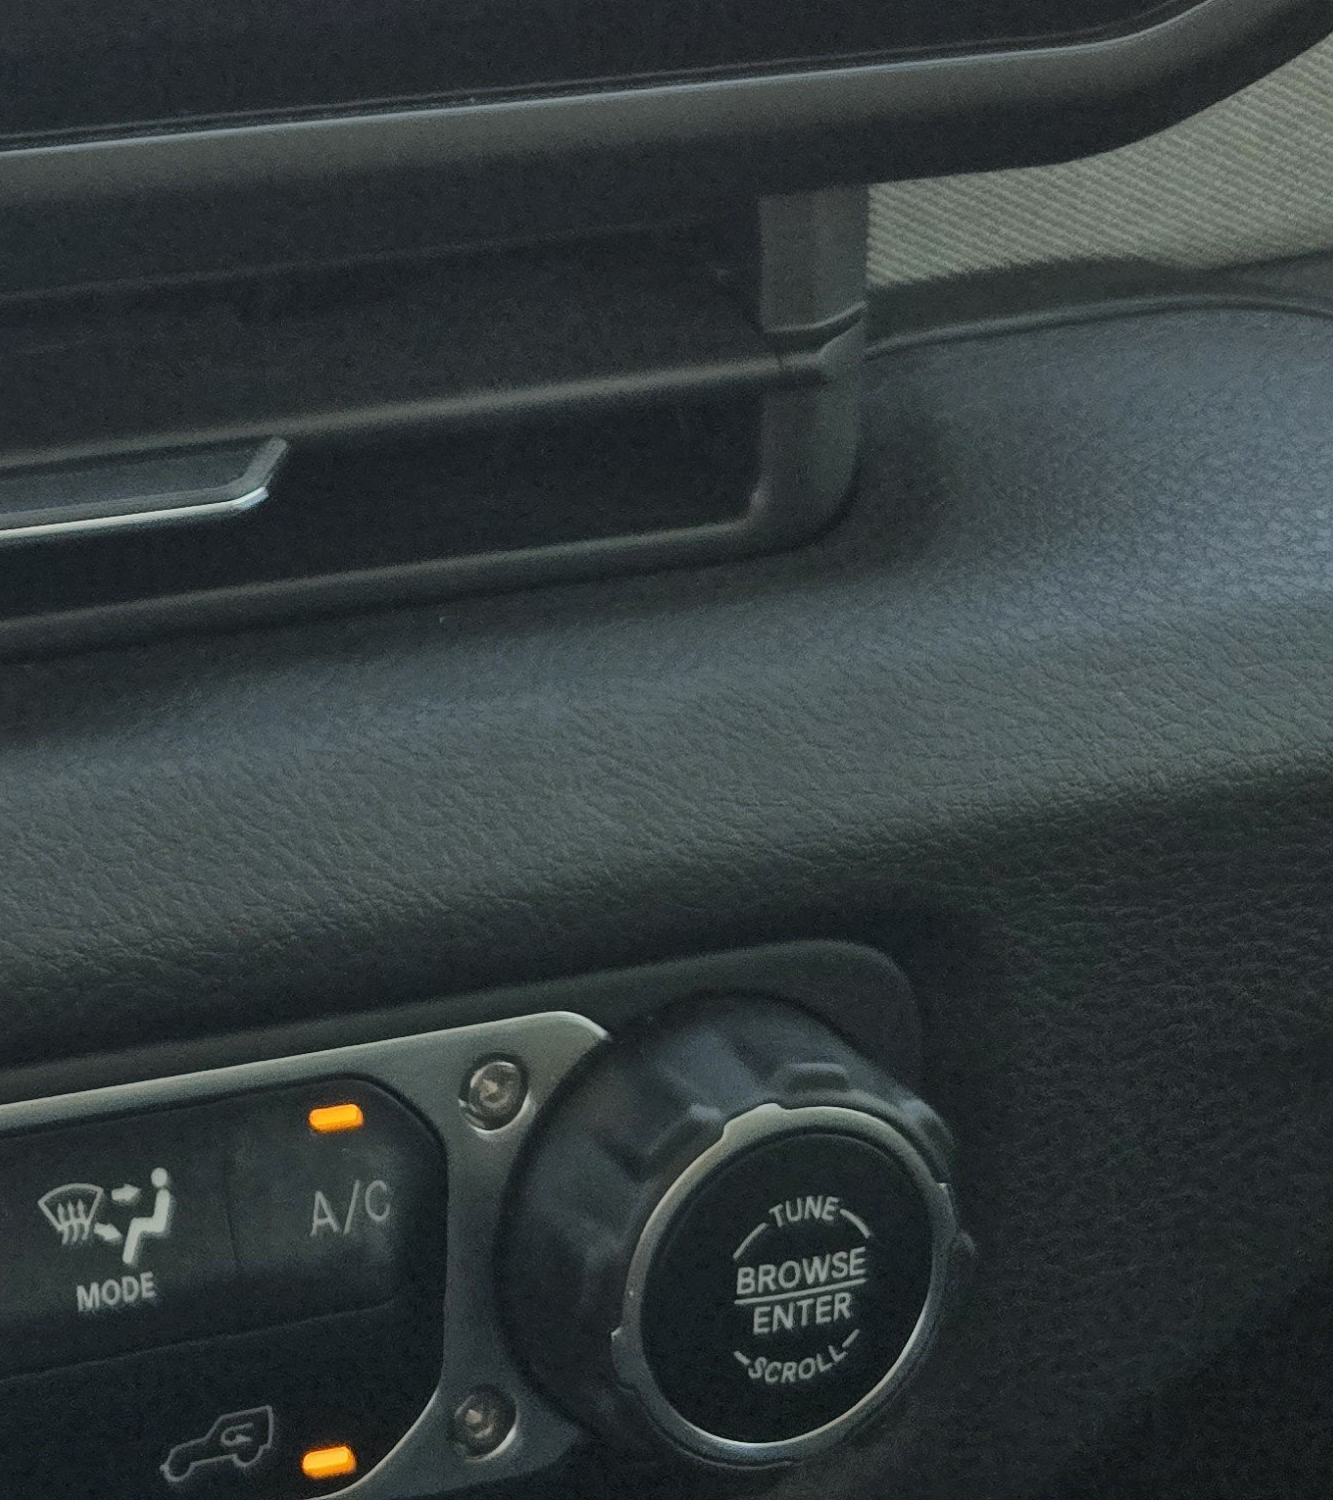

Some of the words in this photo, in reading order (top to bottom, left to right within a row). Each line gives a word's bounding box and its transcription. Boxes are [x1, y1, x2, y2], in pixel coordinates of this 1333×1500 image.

[309, 1179, 391, 1238] A/C
[769, 1195, 840, 1229] TUNE
[75, 1271, 157, 1312] MODE
[736, 1246, 867, 1295] BROWSE
[752, 1292, 852, 1335] ENTER
[747, 1343, 848, 1384] SCROLL
